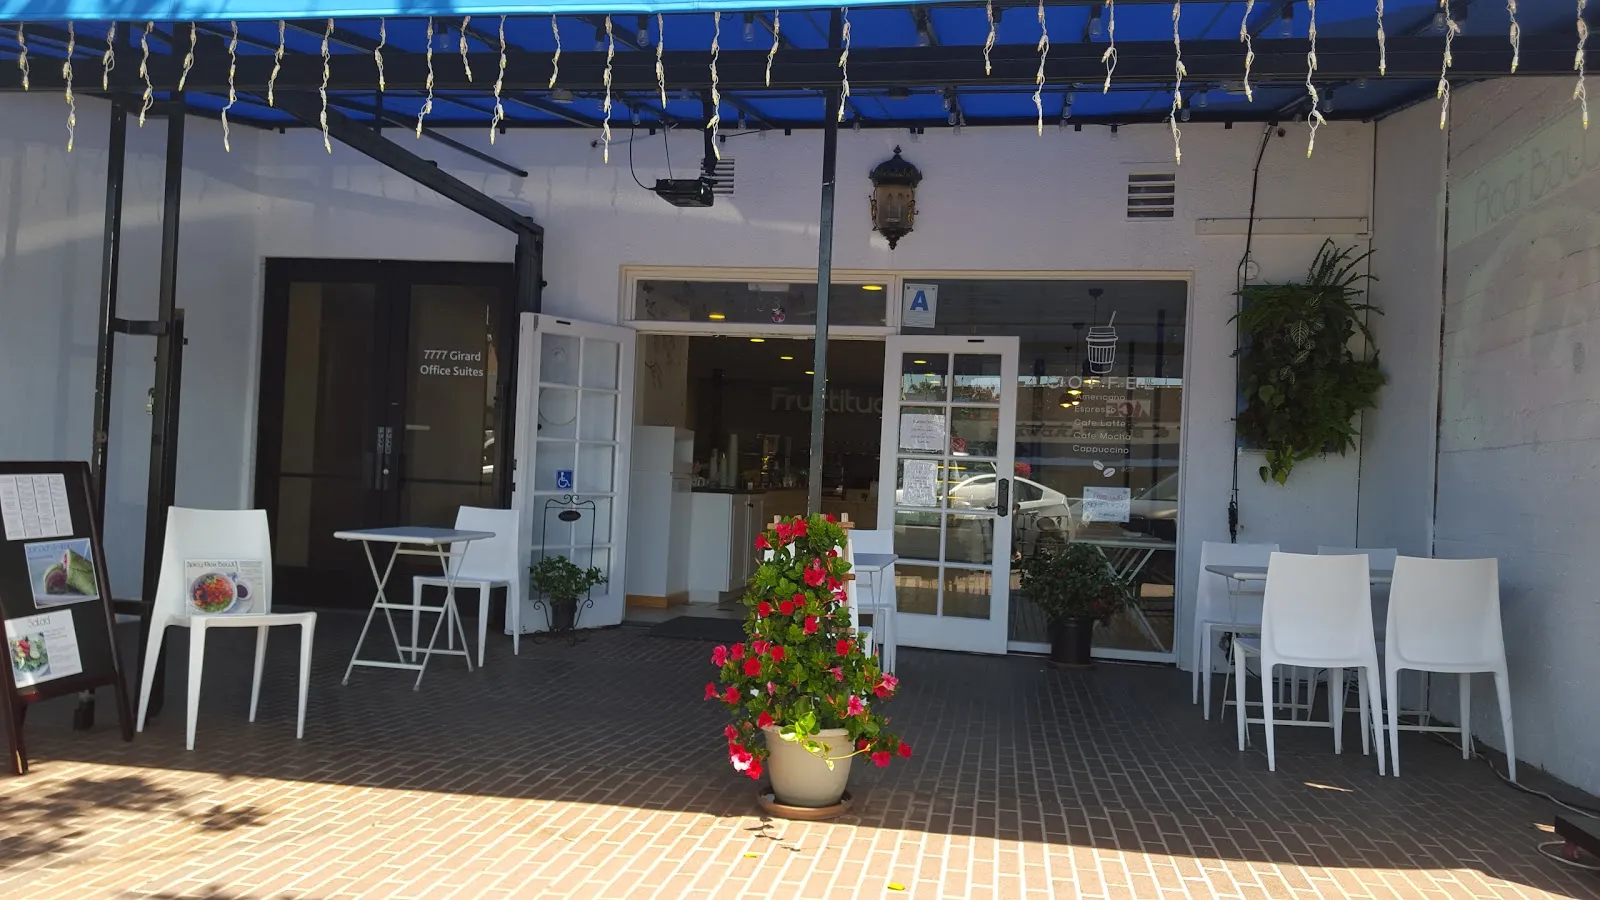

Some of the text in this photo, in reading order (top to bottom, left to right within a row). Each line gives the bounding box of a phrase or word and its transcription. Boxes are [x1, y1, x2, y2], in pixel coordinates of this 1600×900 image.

[910, 290, 929, 311] A
[424, 349, 481, 362] 7777 Girard
[420, 364, 484, 377] Office Suites
[1075, 393, 1126, 401] Americano
[1074, 405, 1117, 414] Espresso
[1074, 418, 1126, 428] Cafe Latte
[1073, 431, 1096, 440] Cafe
[1099, 433, 1131, 441] Mocha
[1072, 444, 1129, 454] Cappuccino
[28, 616, 51, 628] Salad
